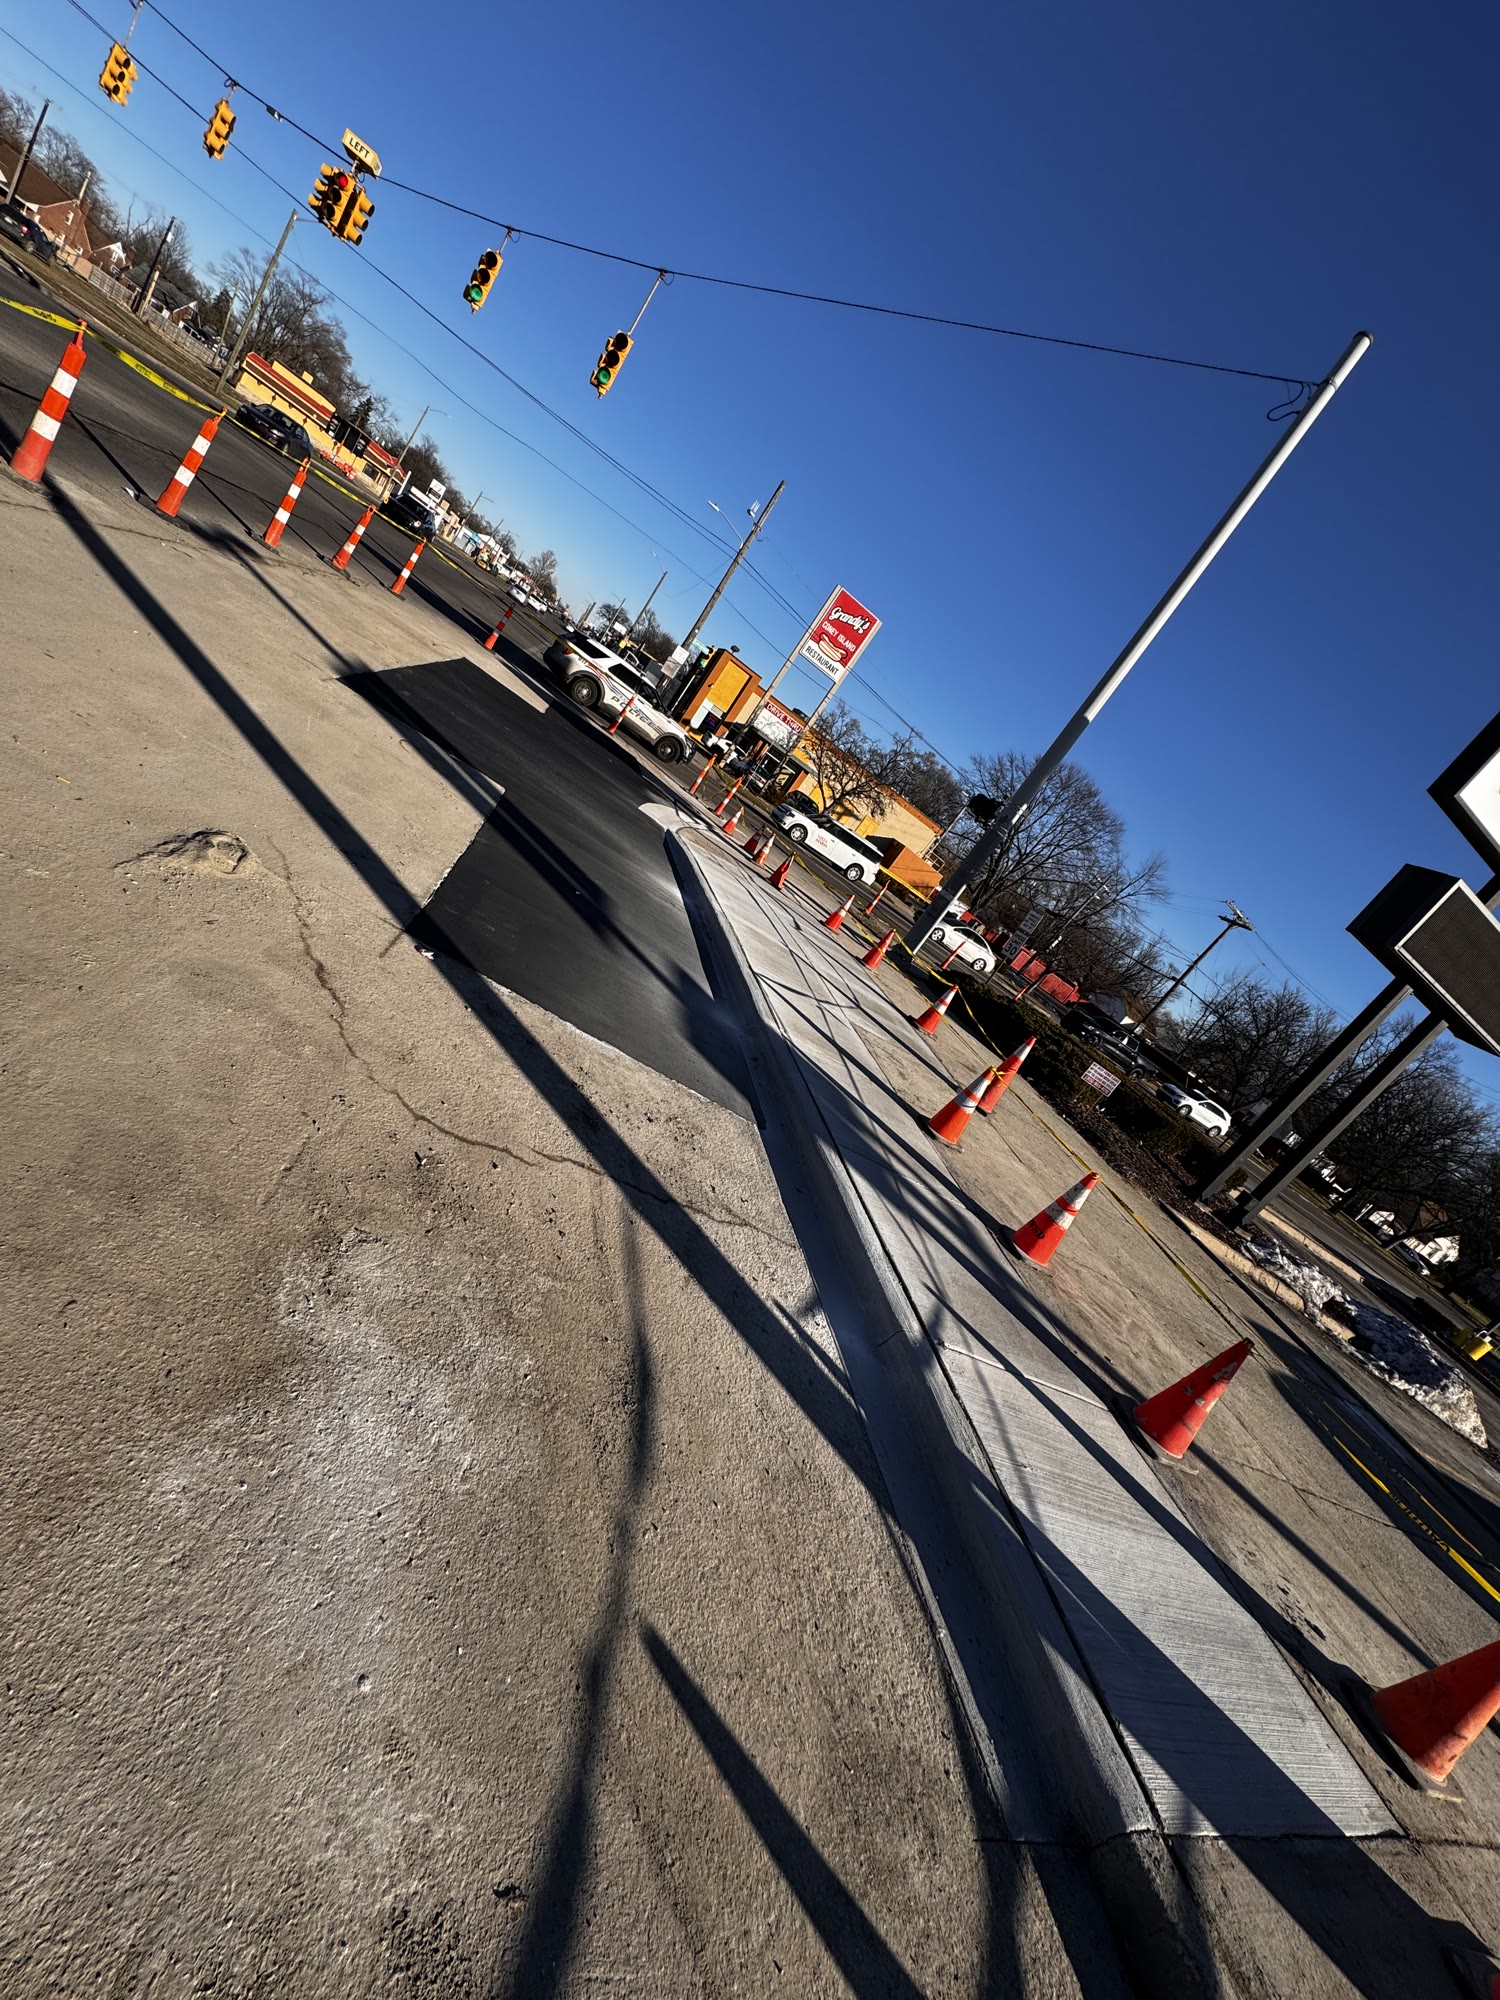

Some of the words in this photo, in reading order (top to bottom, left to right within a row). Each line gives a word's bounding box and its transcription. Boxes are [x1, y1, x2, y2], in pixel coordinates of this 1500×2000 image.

[349, 137, 370, 158] LEFT
[828, 606, 872, 634] Grandy's
[822, 621, 838, 637] CONEY
[837, 634, 857, 652] ISLAND
[805, 645, 840, 676] RESTAURANT
[766, 703, 785, 721] DRIVE
[784, 717, 802, 734] THRU
[1004, 943, 1018, 956] 30
